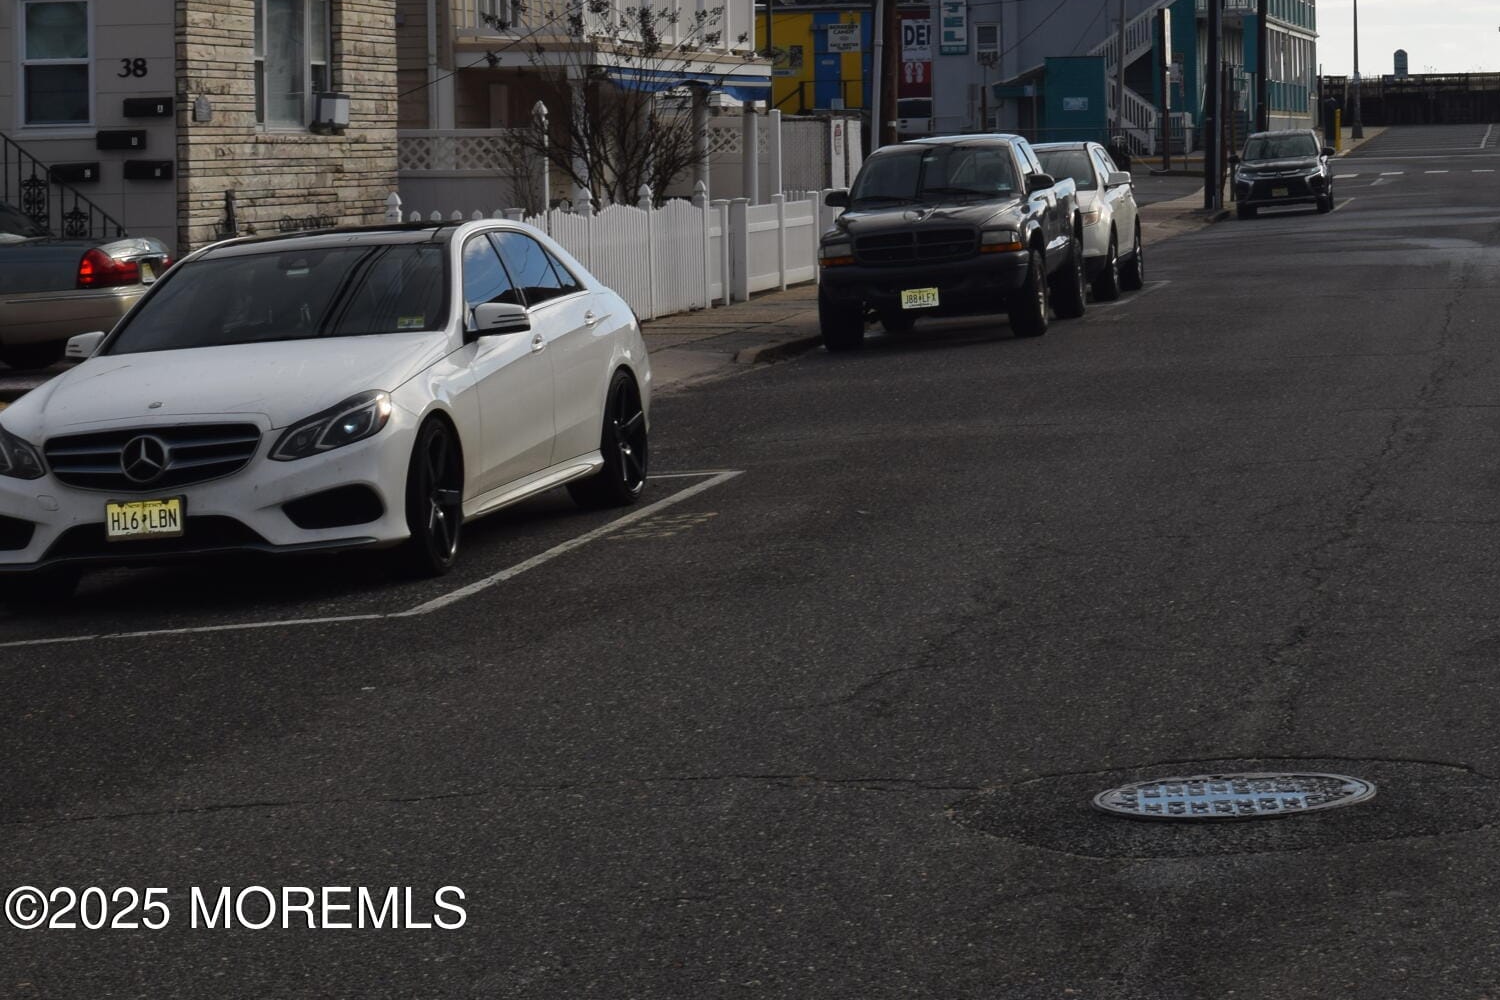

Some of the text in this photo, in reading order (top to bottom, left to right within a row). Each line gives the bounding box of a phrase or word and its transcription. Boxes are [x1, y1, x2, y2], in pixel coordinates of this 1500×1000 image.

[117, 57, 148, 78] 38
[111, 508, 178, 531] H16 LBN
